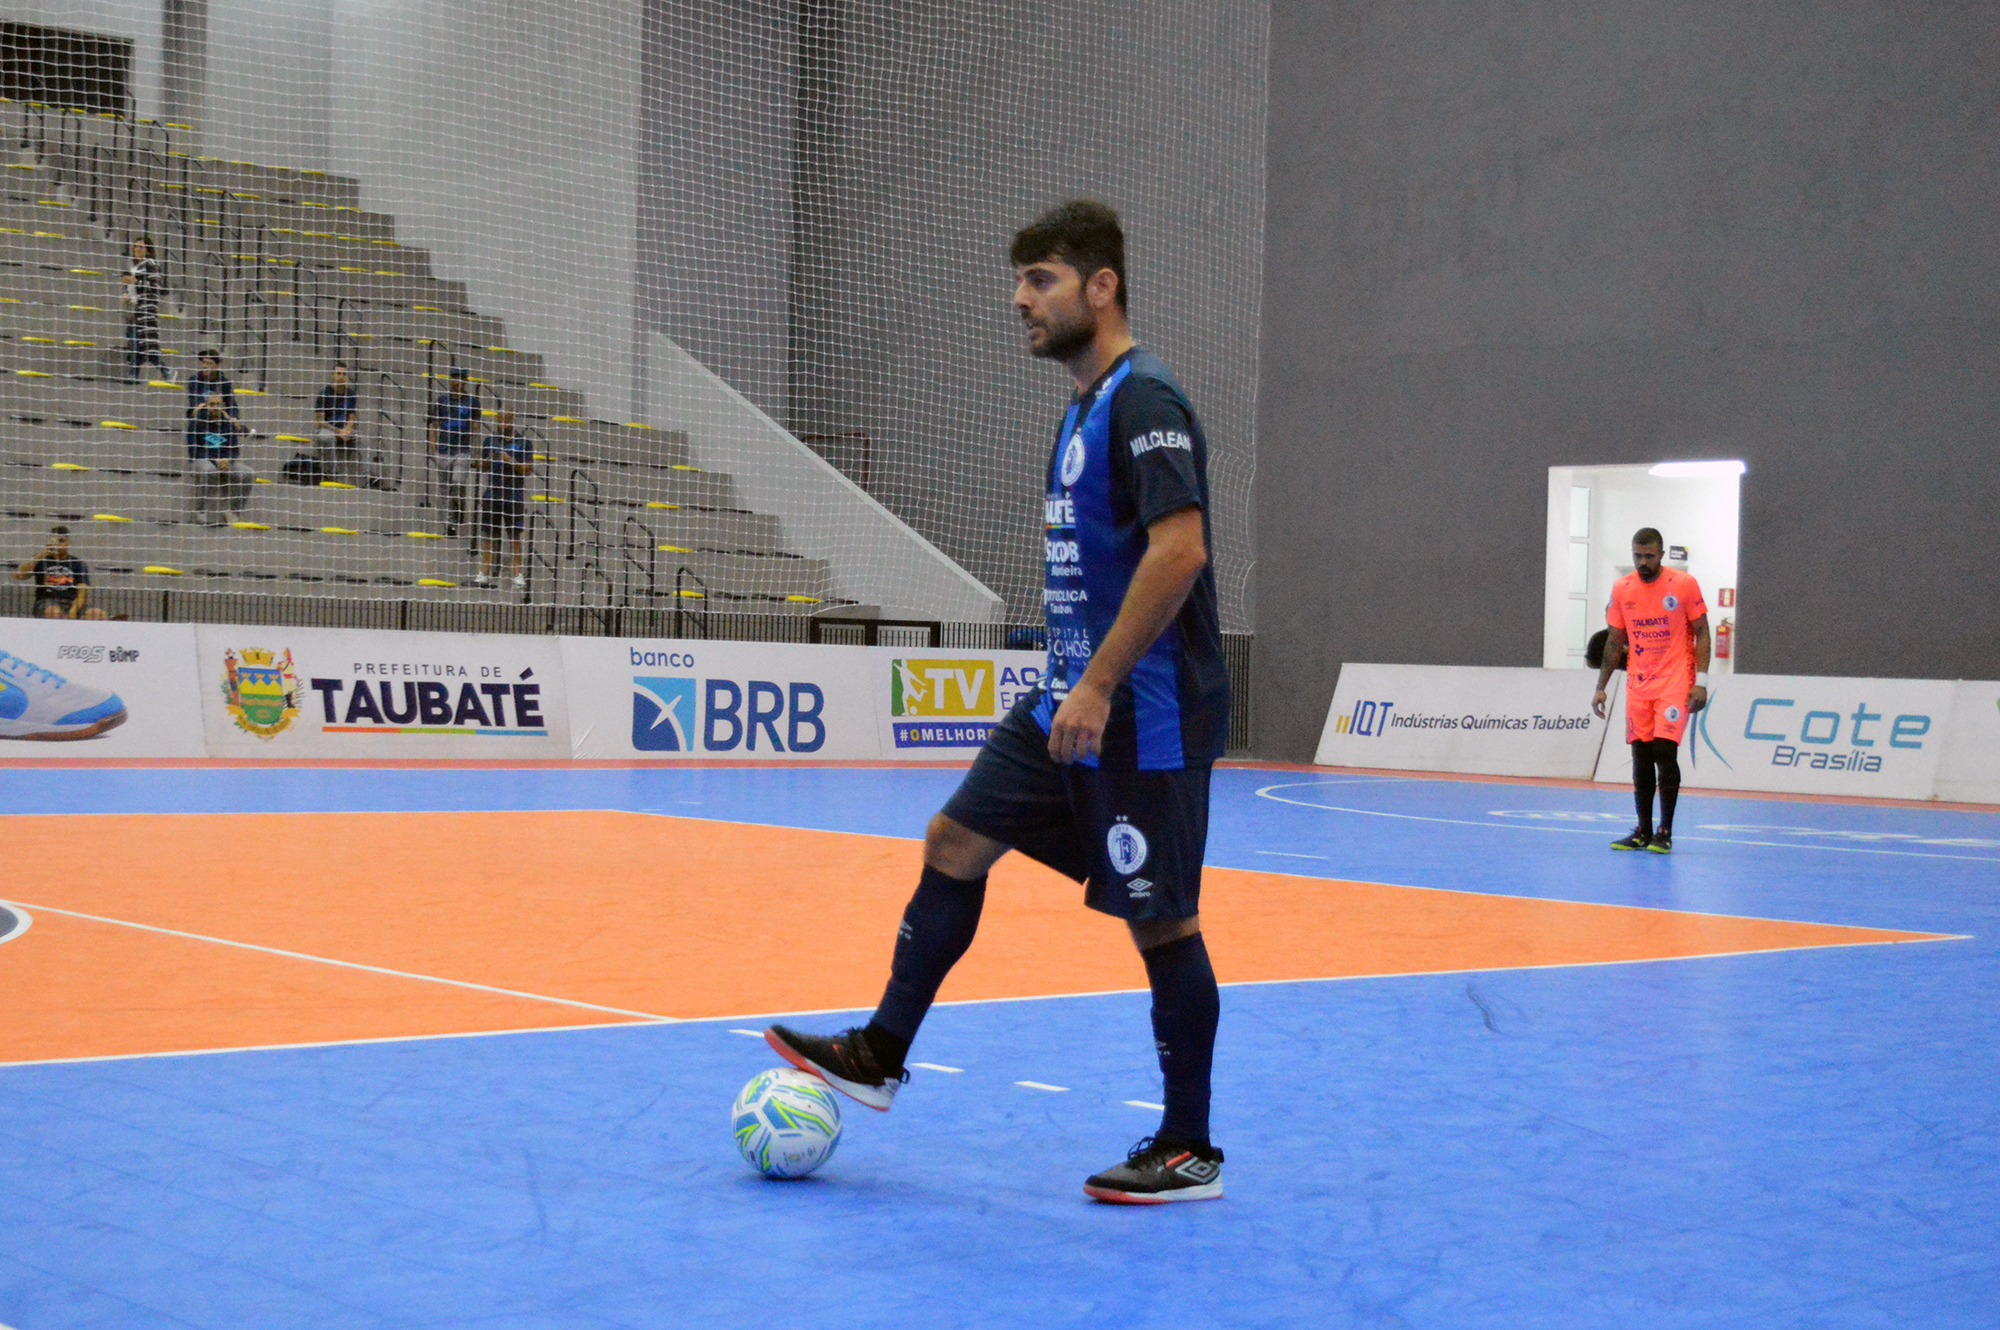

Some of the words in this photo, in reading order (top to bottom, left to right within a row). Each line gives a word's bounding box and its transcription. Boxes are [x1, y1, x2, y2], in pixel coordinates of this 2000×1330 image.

[1632, 614, 1670, 628] TAUBATÉ
[1641, 629, 1671, 639] SICOOB
[353, 662, 468, 677] PREFEITURA
[480, 666, 503, 678] DE
[630, 646, 695, 668] banco
[311, 666, 545, 728] TAUBATÉ
[924, 668, 986, 709] TV
[703, 678, 825, 753] BRB
[1348, 699, 1394, 737] IQT
[1391, 712, 1458, 730] Indústrias
[1460, 714, 1528, 731] Químicas
[1532, 713, 1590, 731] Taubaté
[1744, 697, 1931, 750] Cote
[1771, 745, 1883, 773] Brasília
